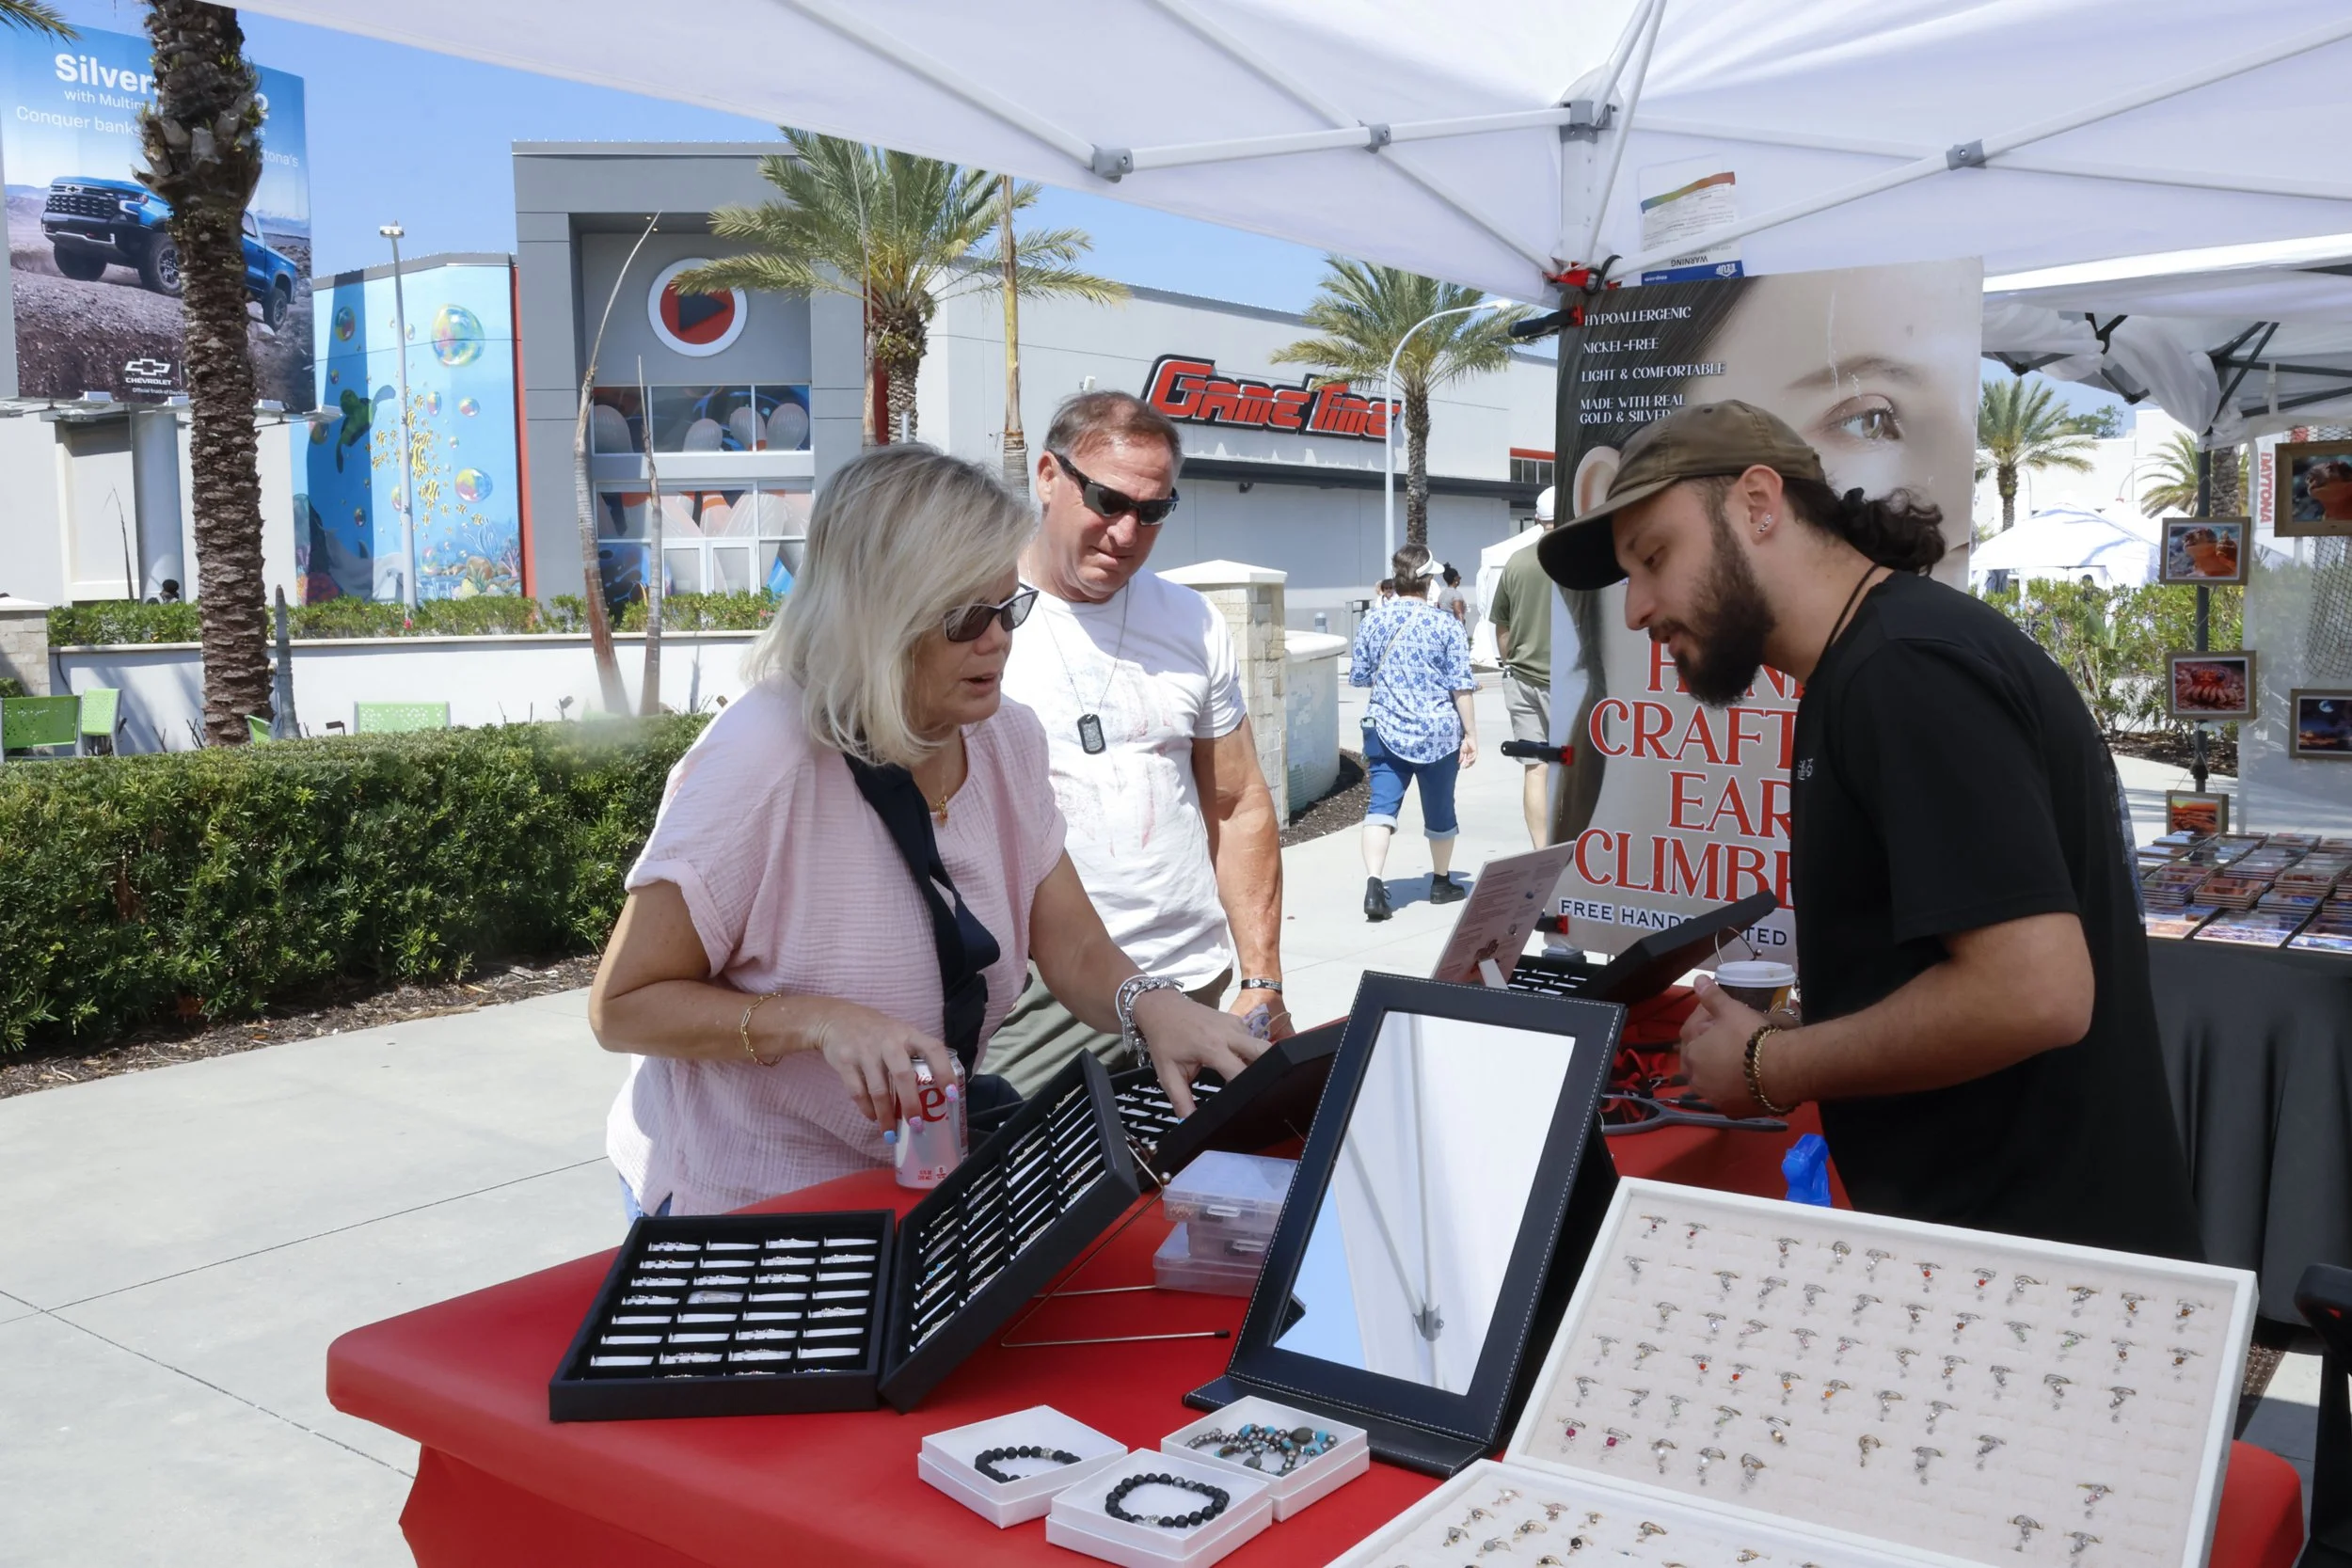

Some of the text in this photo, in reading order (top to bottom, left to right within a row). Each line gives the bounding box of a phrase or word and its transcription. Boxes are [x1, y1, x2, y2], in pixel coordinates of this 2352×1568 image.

[55, 53, 162, 95] Silver
[64, 89, 96, 104] with
[16, 105, 143, 137] Conquer banks
[262, 148, 299, 167] tona's
[1670, 255, 1708, 267] WARNING
[1584, 306, 1692, 326] HYPOALLERGENIC
[1582, 337, 1660, 355] NICKEL-FREE
[125, 376, 172, 386] CHEVROLET
[1581, 362, 1726, 383] LIGHT & COMFORTABLE
[1580, 393, 1687, 411] MADE WITH REAL
[1580, 412, 1613, 424] GOLD
[1615, 410, 1625, 423] &
[2260, 451, 2273, 524] DAYTONA
[1590, 697, 1798, 770] CRAFT
[1560, 898, 1613, 922] FREE
